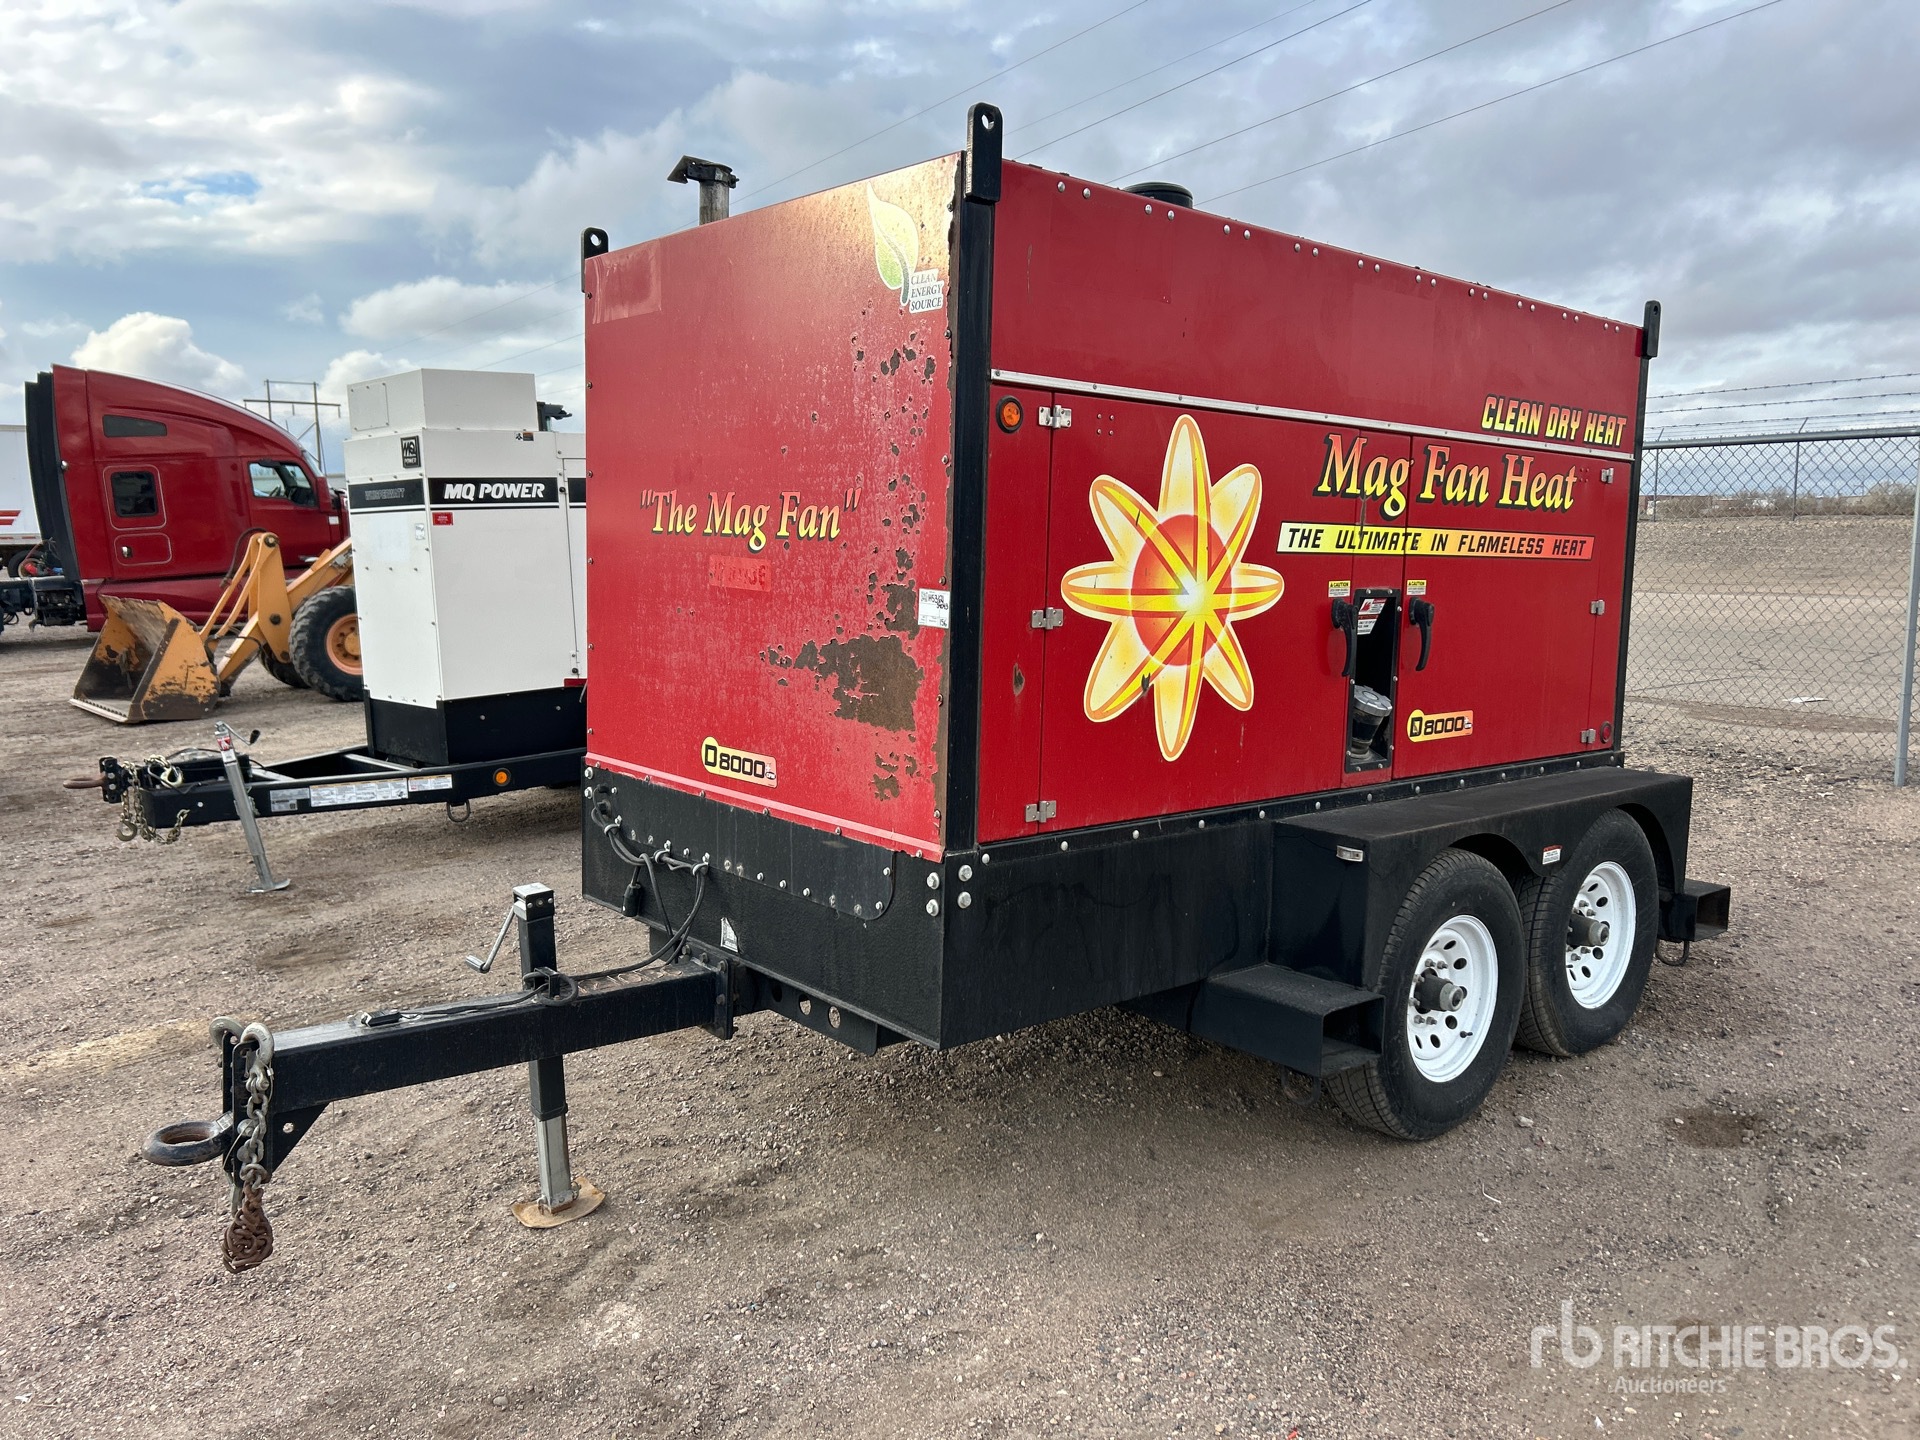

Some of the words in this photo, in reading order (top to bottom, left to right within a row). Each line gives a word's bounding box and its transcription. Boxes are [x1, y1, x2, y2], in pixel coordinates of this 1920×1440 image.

[911, 273, 936, 285] CLEAN
[911, 284, 944, 298] ENERGY
[911, 297, 942, 311] SOURCE
[1480, 394, 1544, 436] CLEAN
[1545, 404, 1583, 441] DRY
[1583, 409, 1628, 447] HEAT
[1314, 433, 1414, 520] Mag
[1416, 444, 1490, 511] Fan
[1497, 453, 1577, 512] Heat
[444, 483, 475, 501] MQ
[478, 483, 545, 499] POWER
[640, 489, 697, 536] "The
[702, 491, 770, 553] Mag
[775, 487, 862, 542] Fan"
[1288, 528, 1324, 549] THE
[1335, 529, 1422, 551] ULTIMATE
[1430, 533, 1449, 552] IN
[1458, 534, 1544, 555] FLAMELESS
[1552, 539, 1587, 556] HEAT
